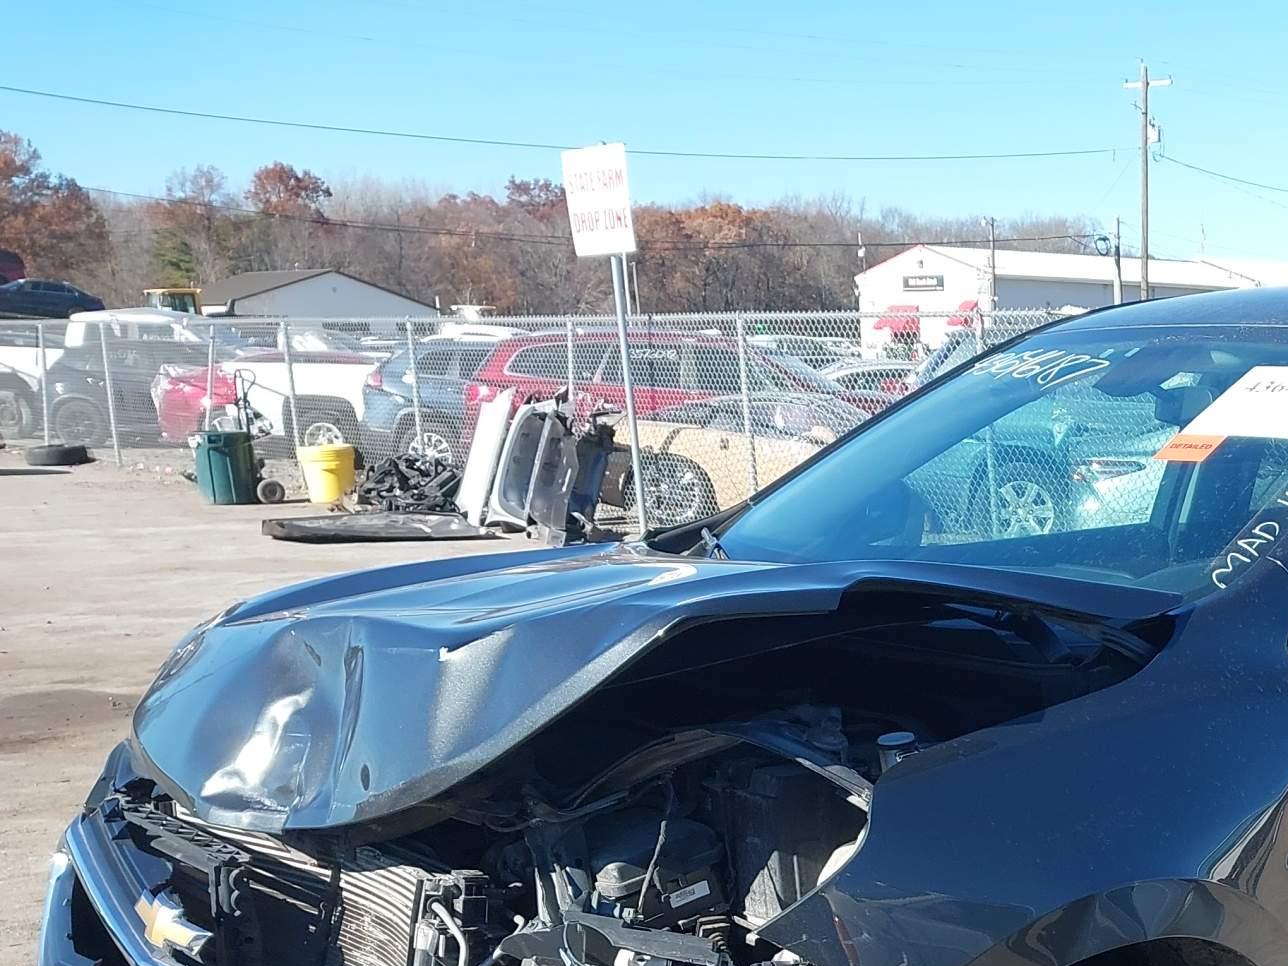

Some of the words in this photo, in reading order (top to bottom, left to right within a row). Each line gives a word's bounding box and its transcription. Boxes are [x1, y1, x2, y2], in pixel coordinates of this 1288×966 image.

[569, 172, 595, 194] STATE
[597, 168, 624, 192] FARM
[572, 211, 600, 232] DROP
[604, 207, 628, 229] ZONE
[1169, 442, 1213, 450] DETAILED
[1212, 521, 1280, 589] MAD
